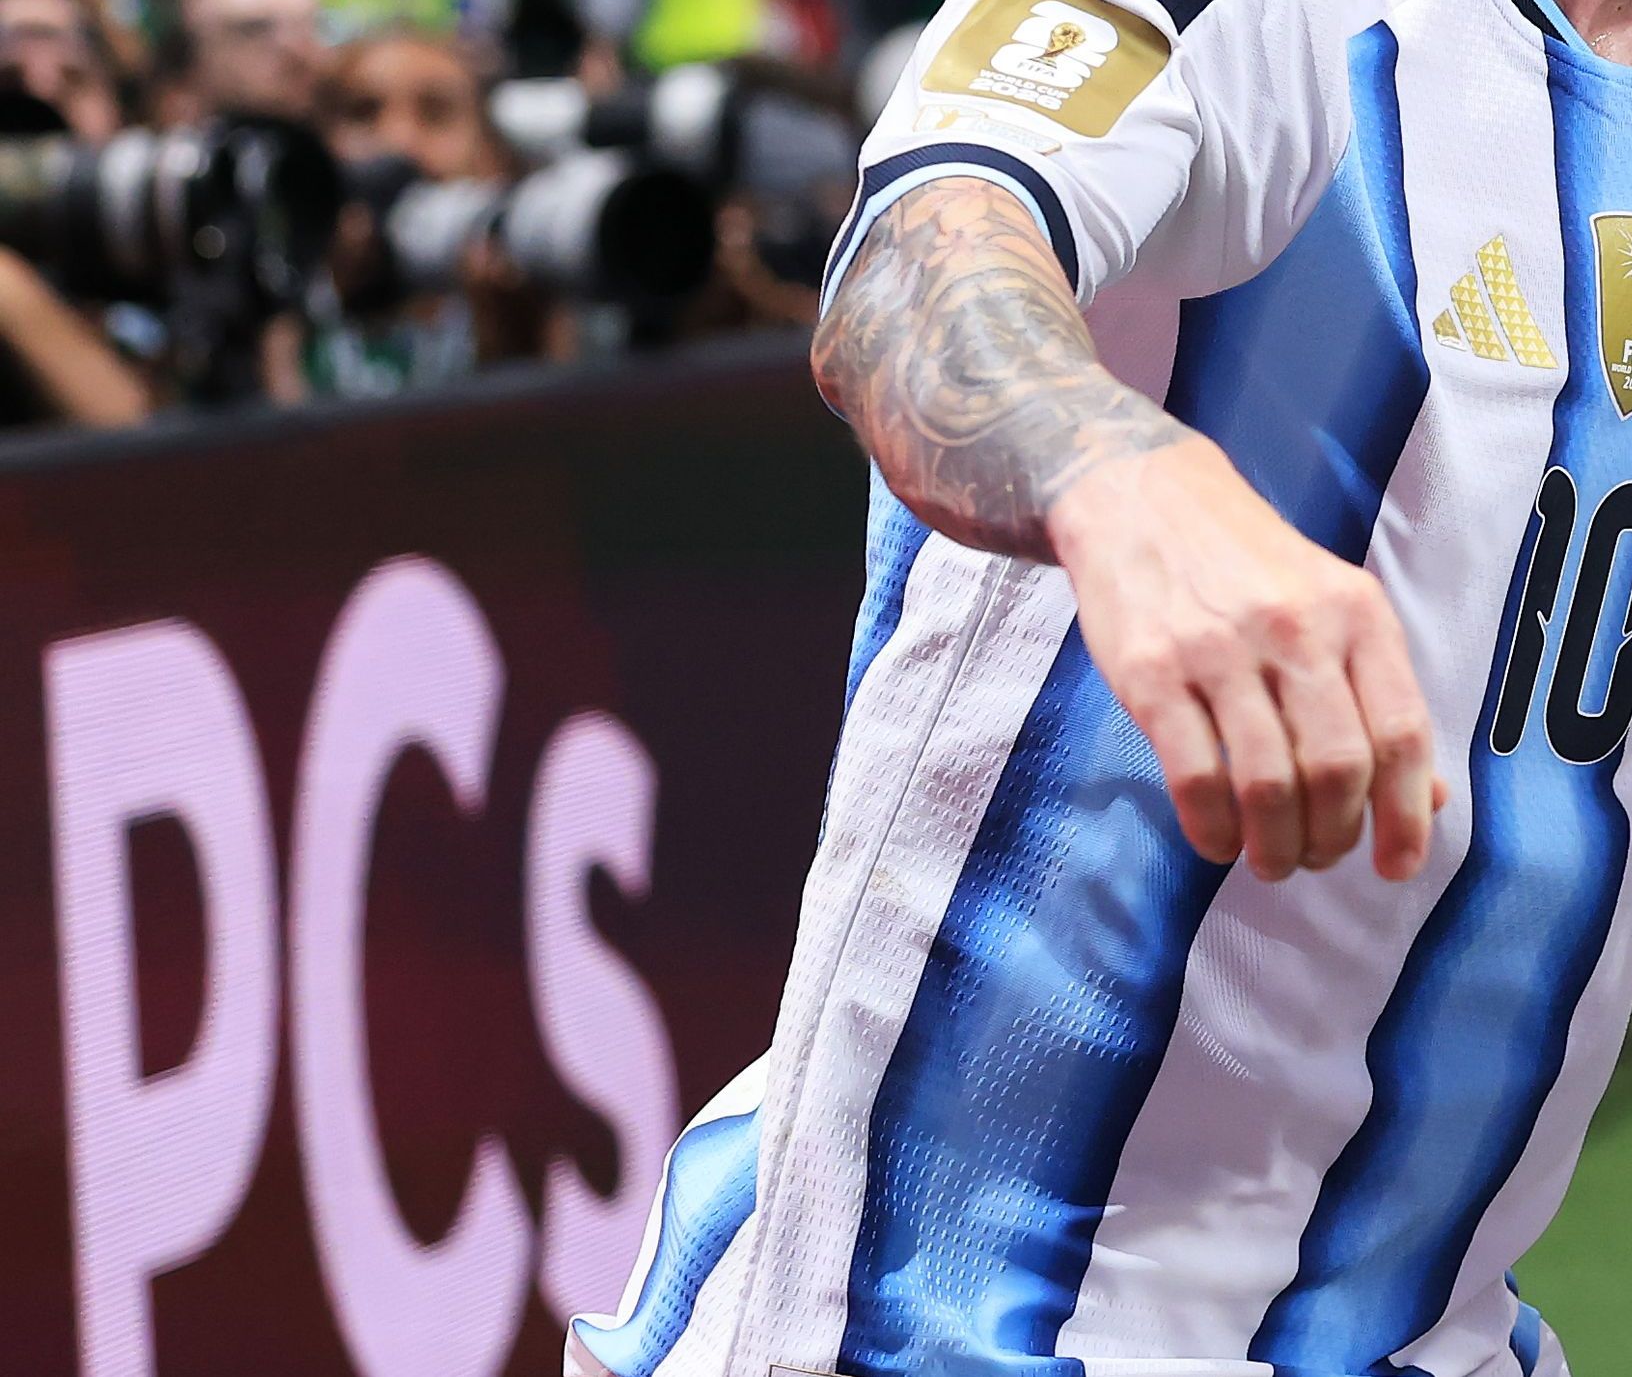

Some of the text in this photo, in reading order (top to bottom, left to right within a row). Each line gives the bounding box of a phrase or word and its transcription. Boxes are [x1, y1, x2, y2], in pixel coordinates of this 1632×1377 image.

[980, 69, 1036, 90] WORLD
[1017, 62, 1055, 78] FIFA
[968, 77, 1063, 111] 2026
[42, 553, 682, 1377] PCs
